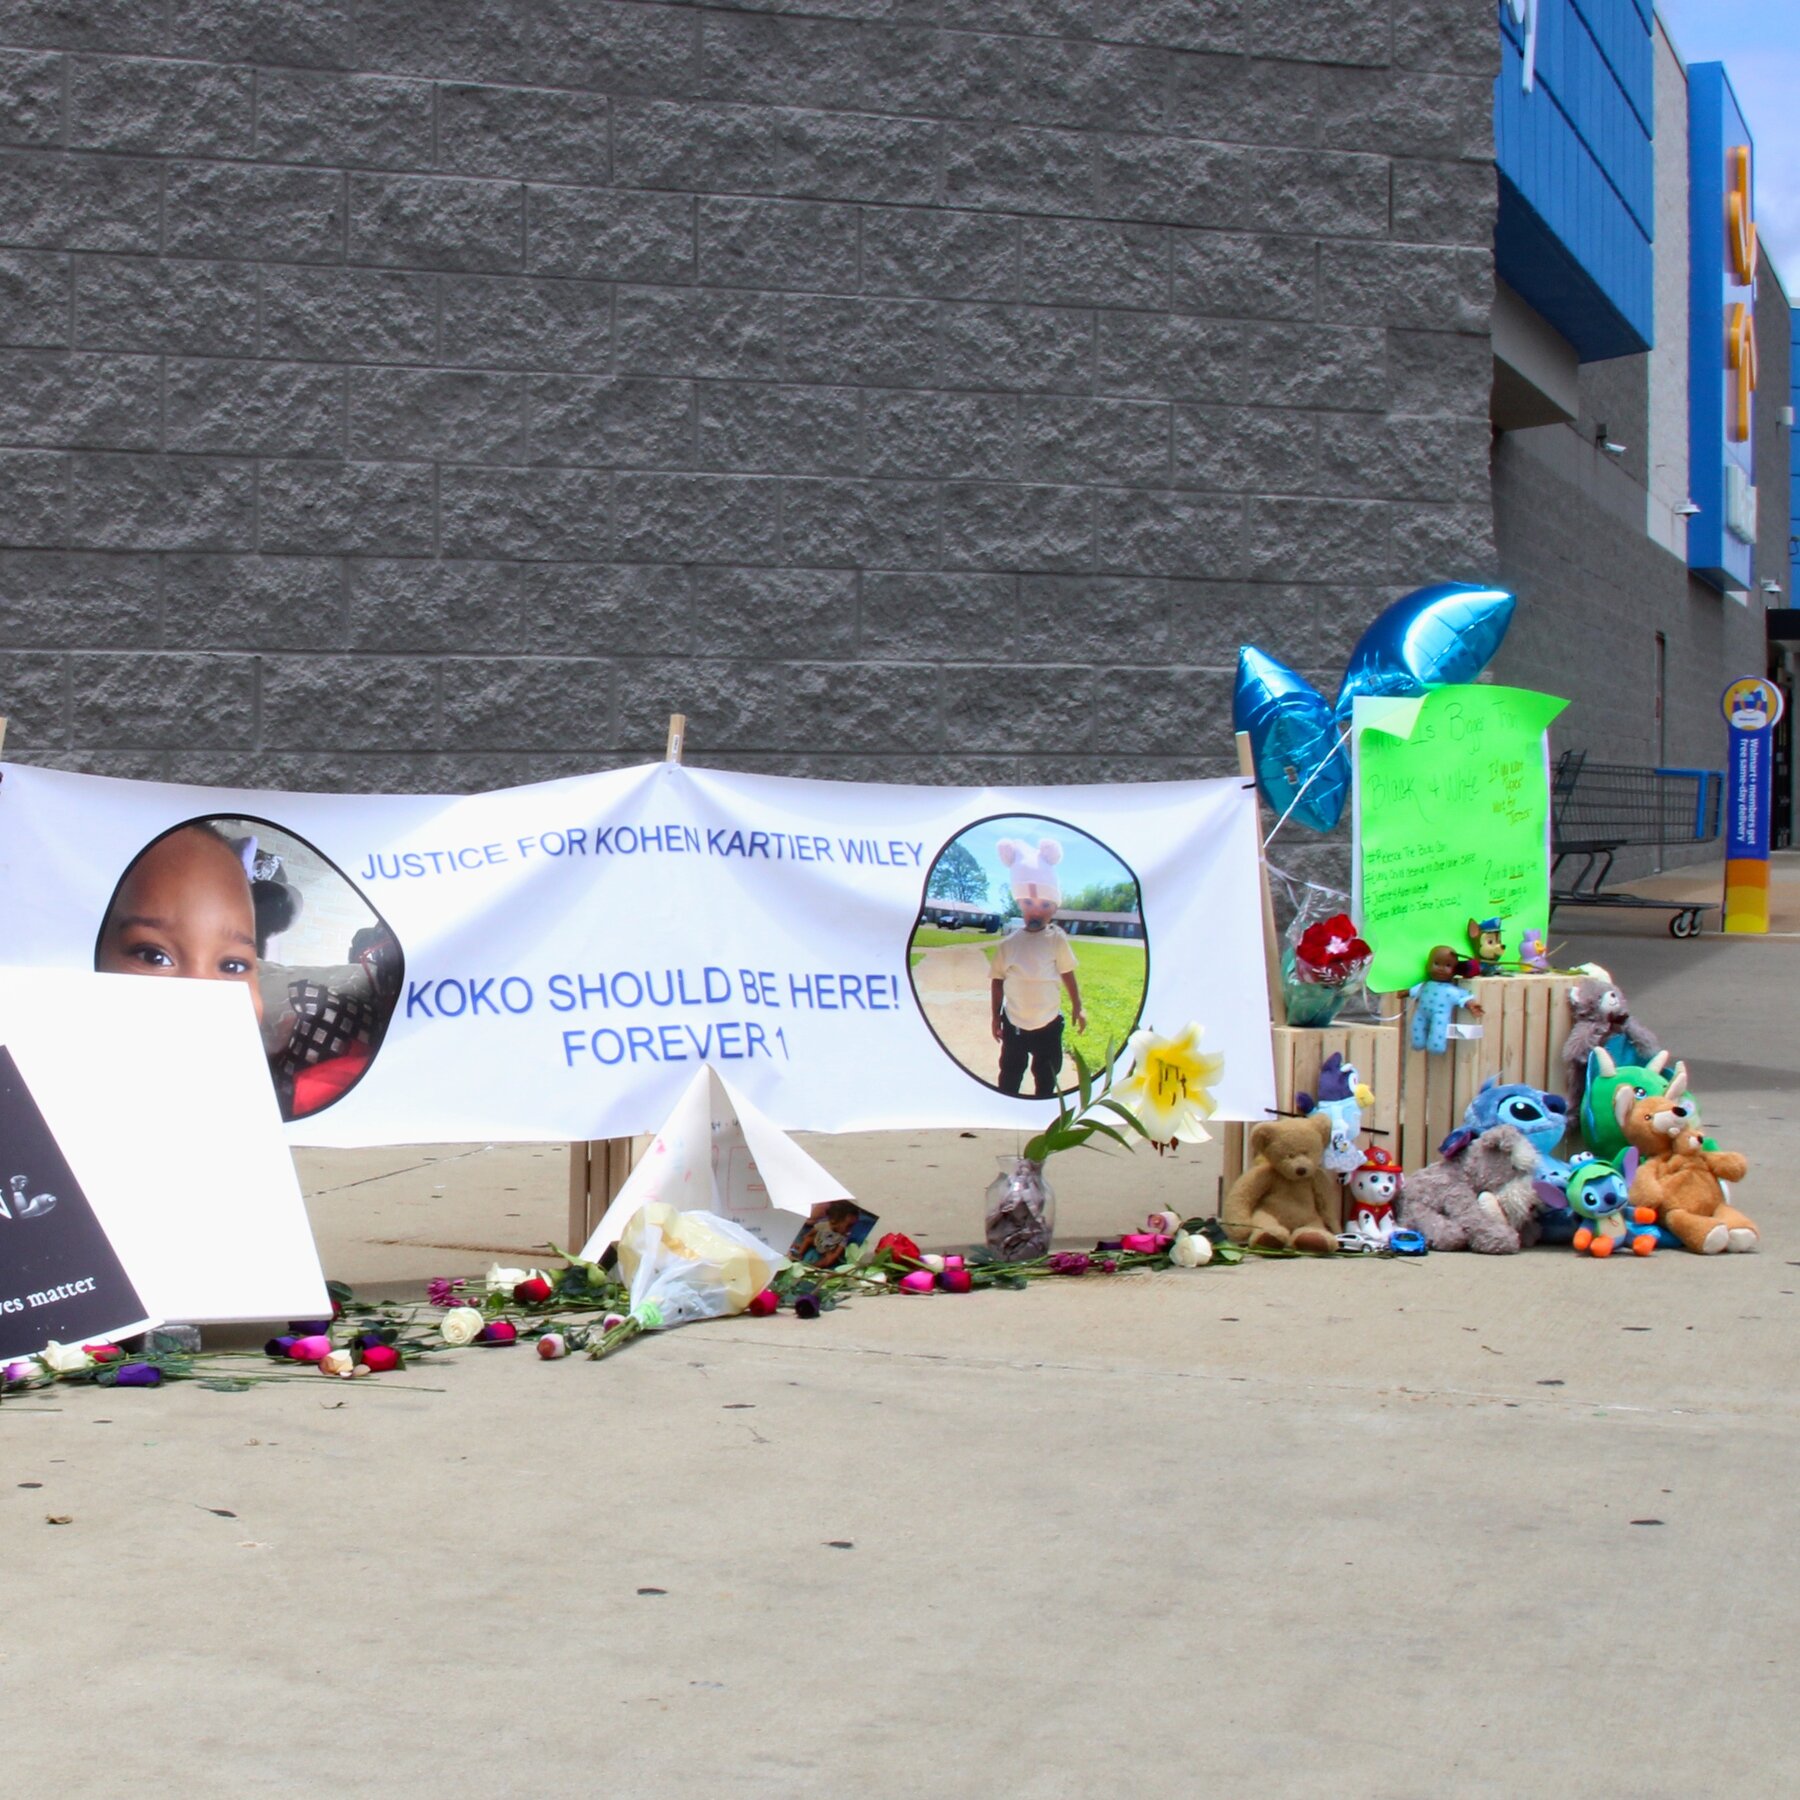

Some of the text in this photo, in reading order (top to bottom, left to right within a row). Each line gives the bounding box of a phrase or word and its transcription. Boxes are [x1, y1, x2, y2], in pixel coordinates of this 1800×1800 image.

[1736, 738, 1749, 843] free same-day delivery
[1747, 784, 1758, 828] members
[361, 823, 924, 880] JUSTICE FOR KOHEN KARTIER WILEY
[405, 966, 902, 1020] KOKO SHOULD BE HERE!
[0, 1276, 96, 1316] es matter
